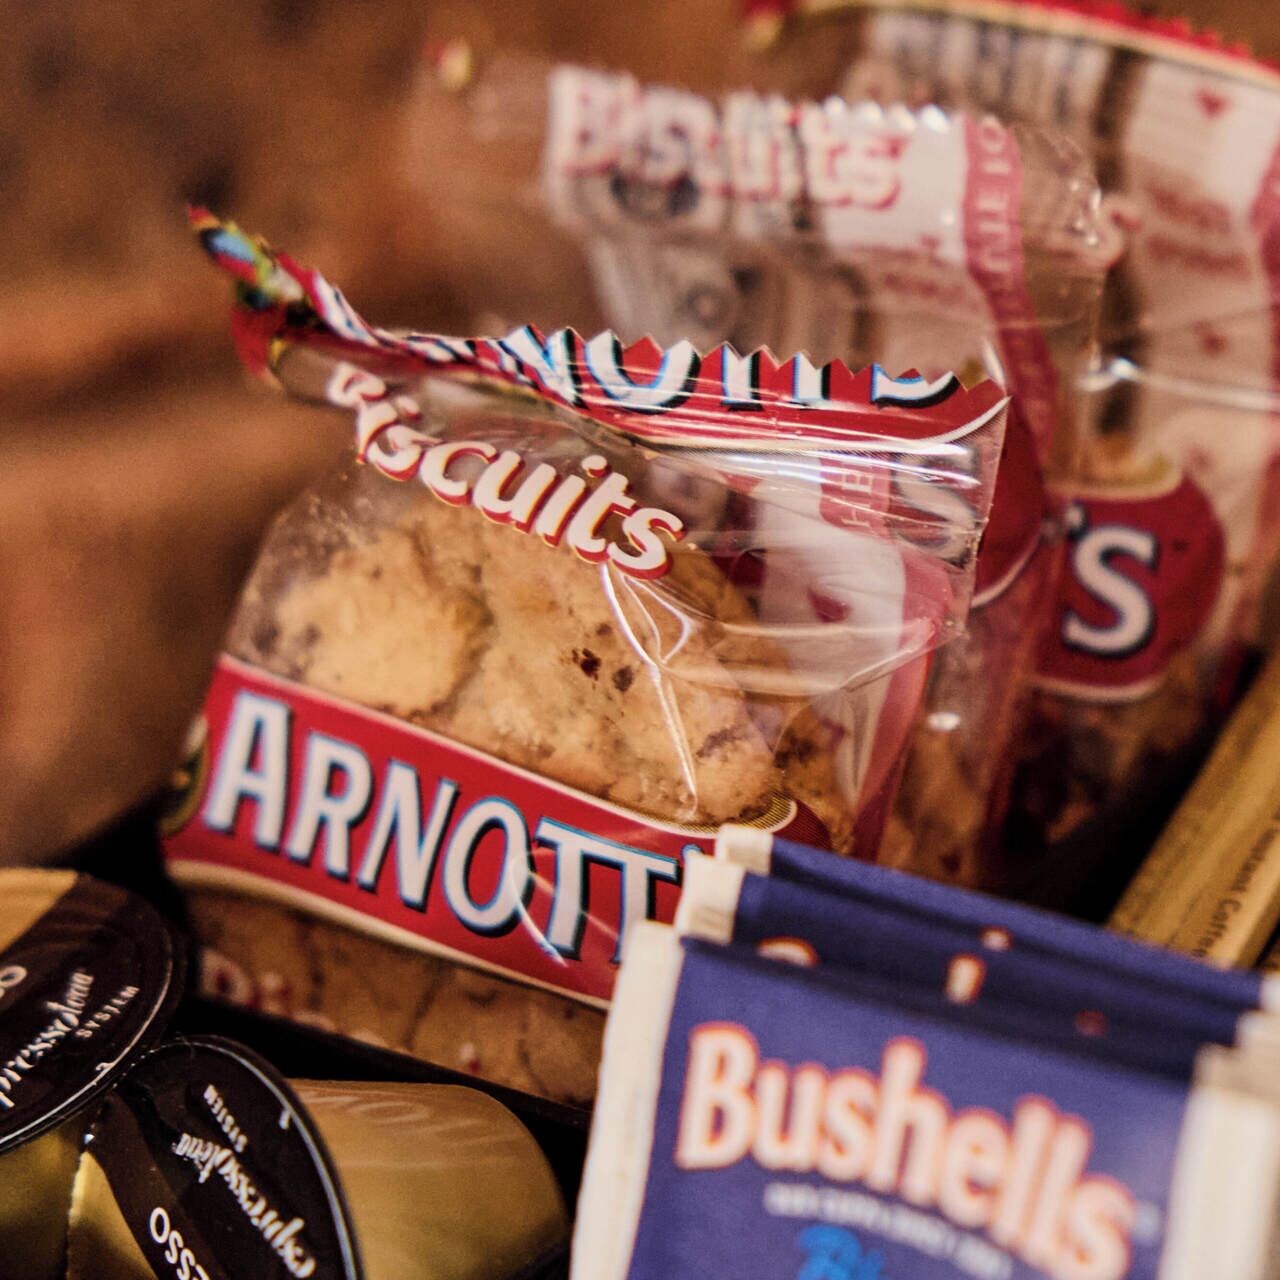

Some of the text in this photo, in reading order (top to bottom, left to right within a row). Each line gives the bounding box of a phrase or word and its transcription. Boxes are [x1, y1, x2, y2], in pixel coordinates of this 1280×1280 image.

[203, 689, 704, 965] ARNOTT
[75, 986, 141, 1039] SYSTEM
[203, 1084, 248, 1153] SYSTEM
